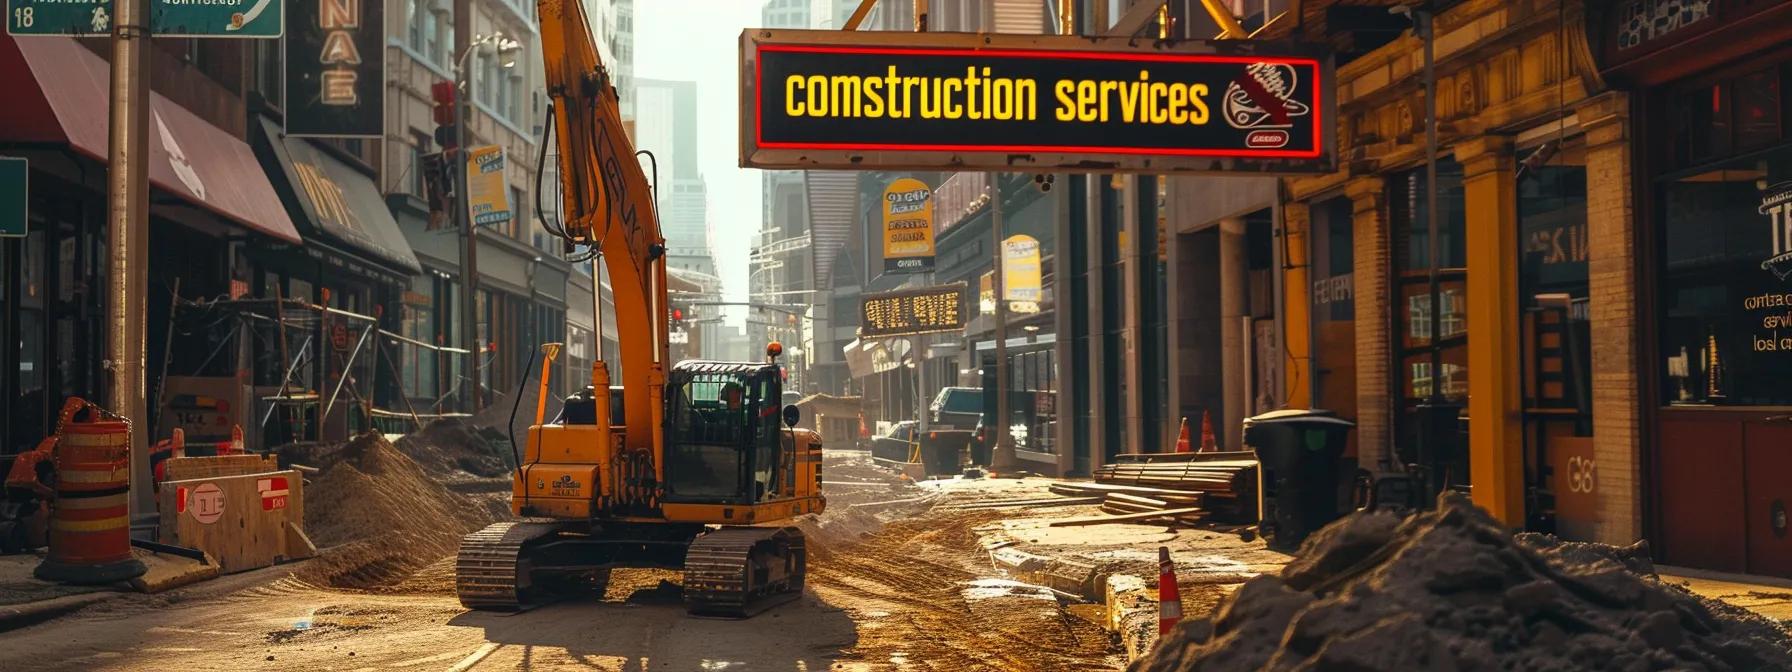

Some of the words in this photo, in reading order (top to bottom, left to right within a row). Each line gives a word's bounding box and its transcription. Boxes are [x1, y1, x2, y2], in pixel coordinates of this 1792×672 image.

[15, 6, 34, 28] 18
[786, 65, 1036, 120] comstruction
[1055, 70, 1209, 125] services
